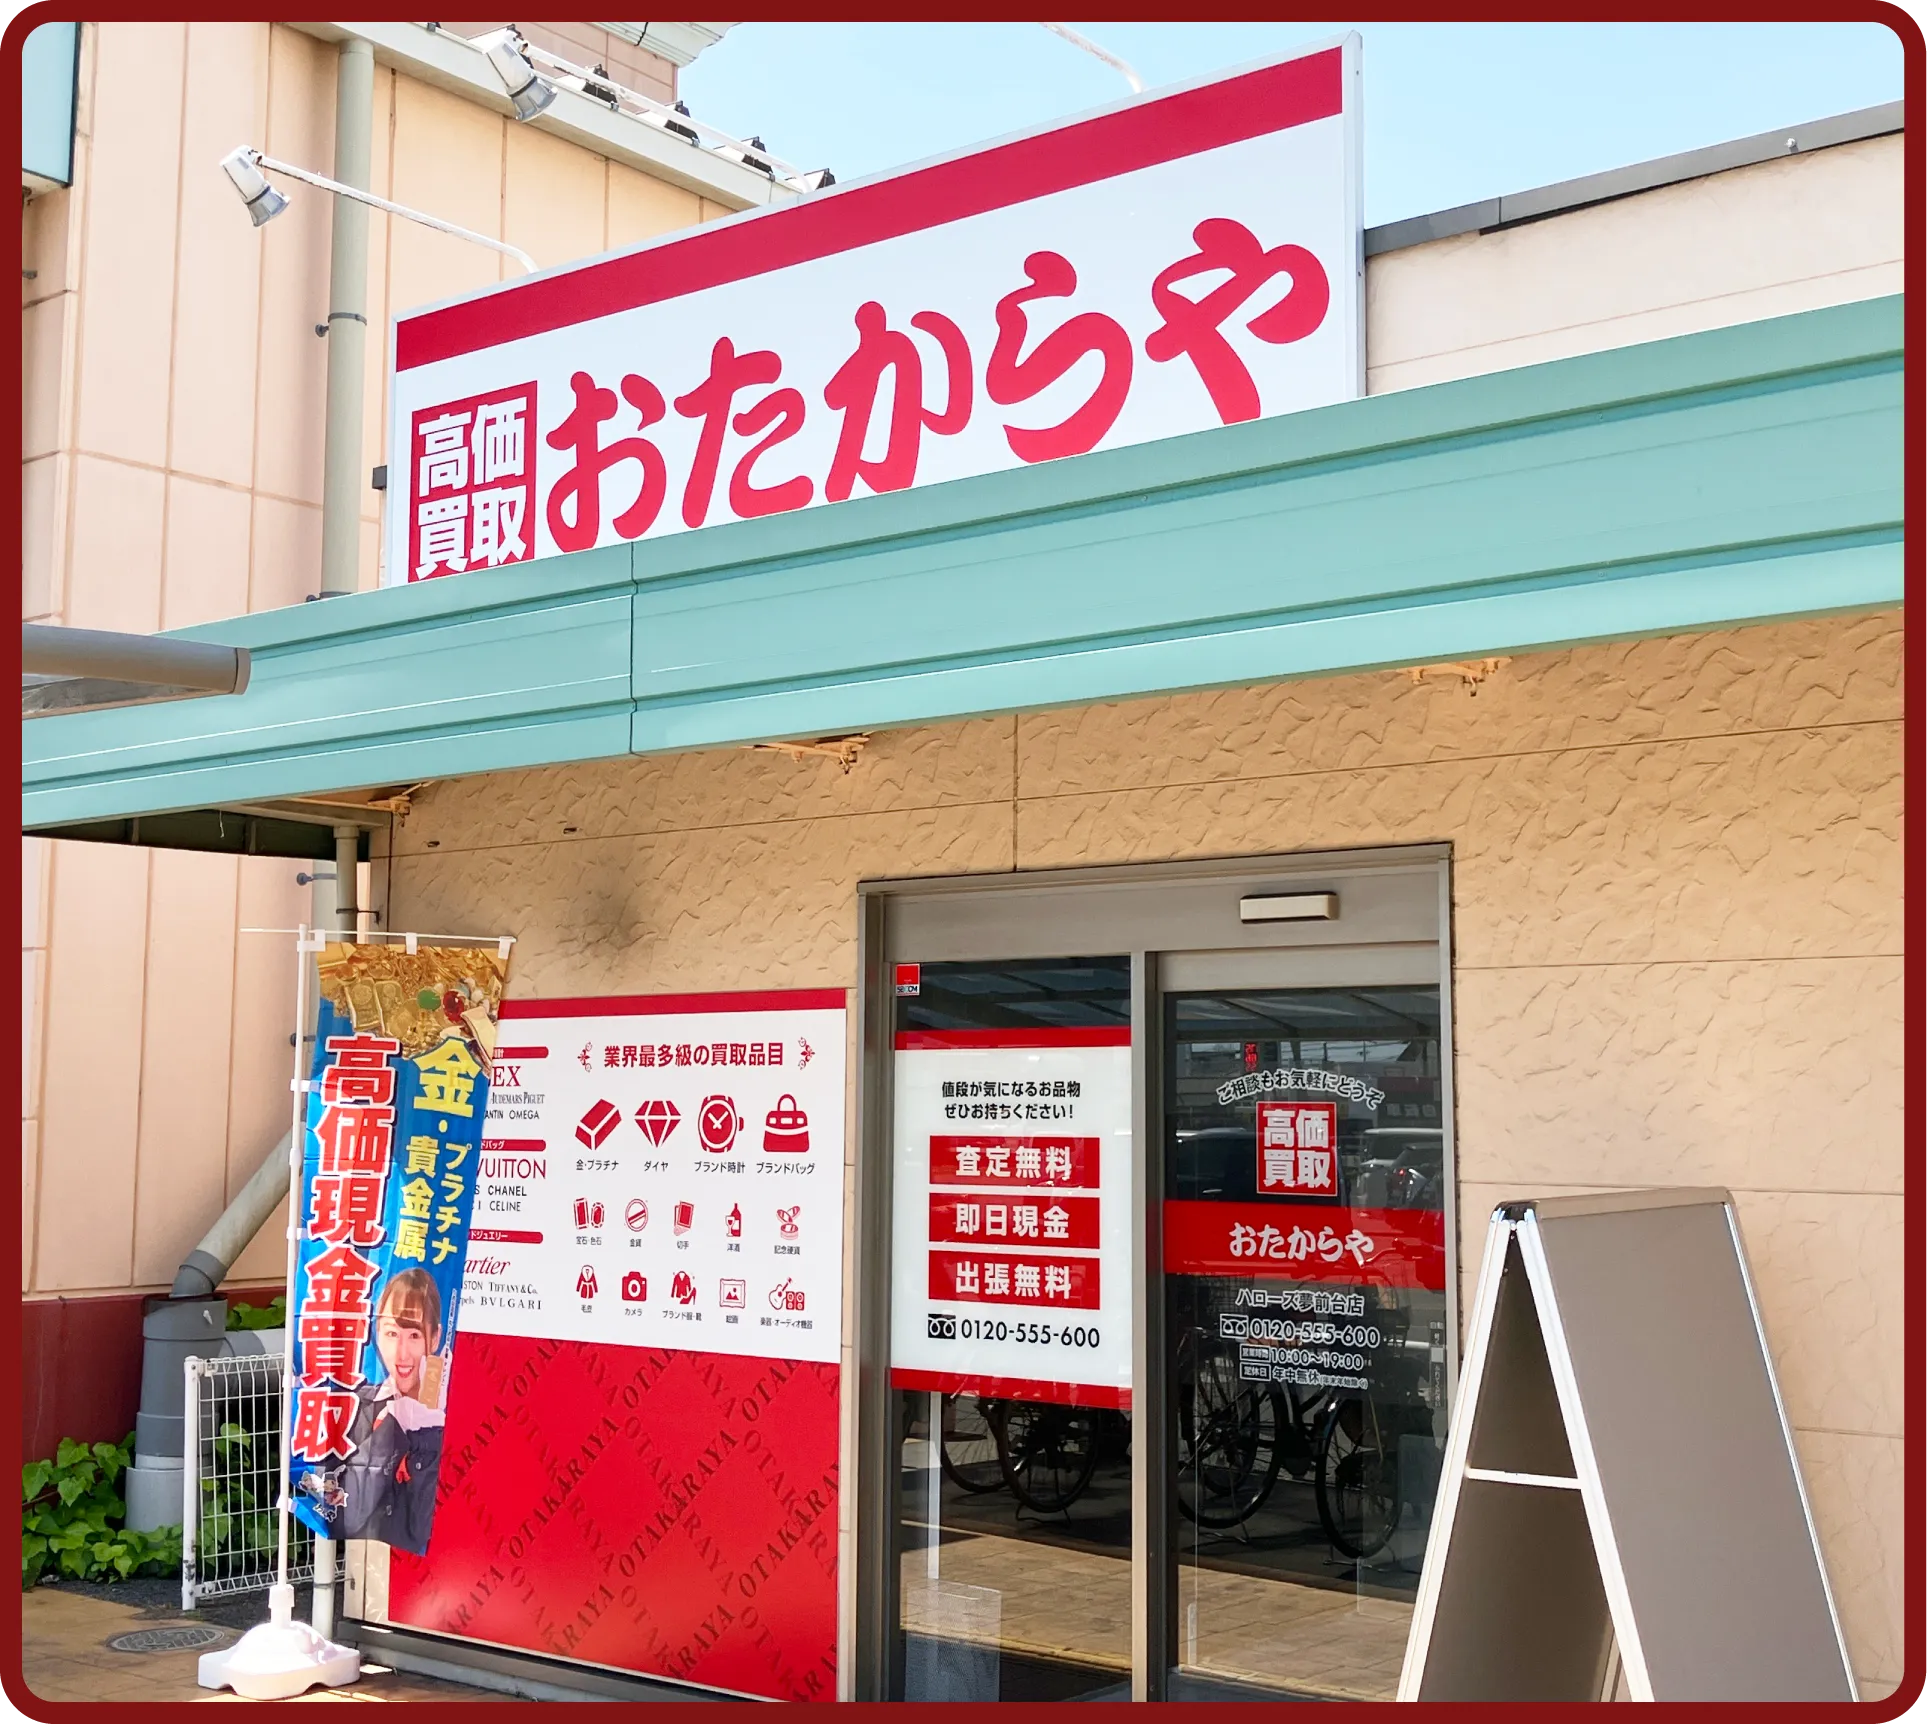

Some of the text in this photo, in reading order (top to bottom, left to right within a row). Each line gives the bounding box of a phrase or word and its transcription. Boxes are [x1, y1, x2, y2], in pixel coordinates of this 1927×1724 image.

[546, 217, 1330, 553] おたからや
[419, 396, 527, 497] 高価
[416, 485, 527, 580] 買取
[604, 1043, 783, 1068] 業界最多級の買取品目
[941, 1081, 1081, 1099] 値段が気になるお品物
[1216, 1068, 1385, 1110] ご相談もお気軽にどうぞ
[508, 1109, 540, 1120] OMEGA
[944, 1103, 1074, 1120] ぜひお持ちください！
[1263, 1109, 1330, 1149] 高価
[576, 1159, 816, 1175] 金・プラチナ ダイヤ ブランド時計 ブランドバッグ
[955, 1145, 1073, 1181] 査定無料
[1263, 1149, 1332, 1189] 買取
[393, 1135, 437, 1263] 貴金属
[431, 1141, 473, 1266] プラチナ
[488, 1185, 527, 1197] CHANEL
[489, 1200, 522, 1212] CELINE
[955, 1204, 1071, 1240] 即日現金
[292, 1033, 399, 1461] 高価現金買取
[1229, 1221, 1375, 1270] おたからや
[955, 1261, 1073, 1300] 出張無料
[480, 1296, 542, 1311] BVLGARI
[624, 1307, 643, 1316] カメラ
[1235, 1288, 1365, 1316] ハローズ夢前台店
[961, 1318, 1101, 1349] 0120-555-600
[1250, 1318, 1381, 1349] 0120-555-600
